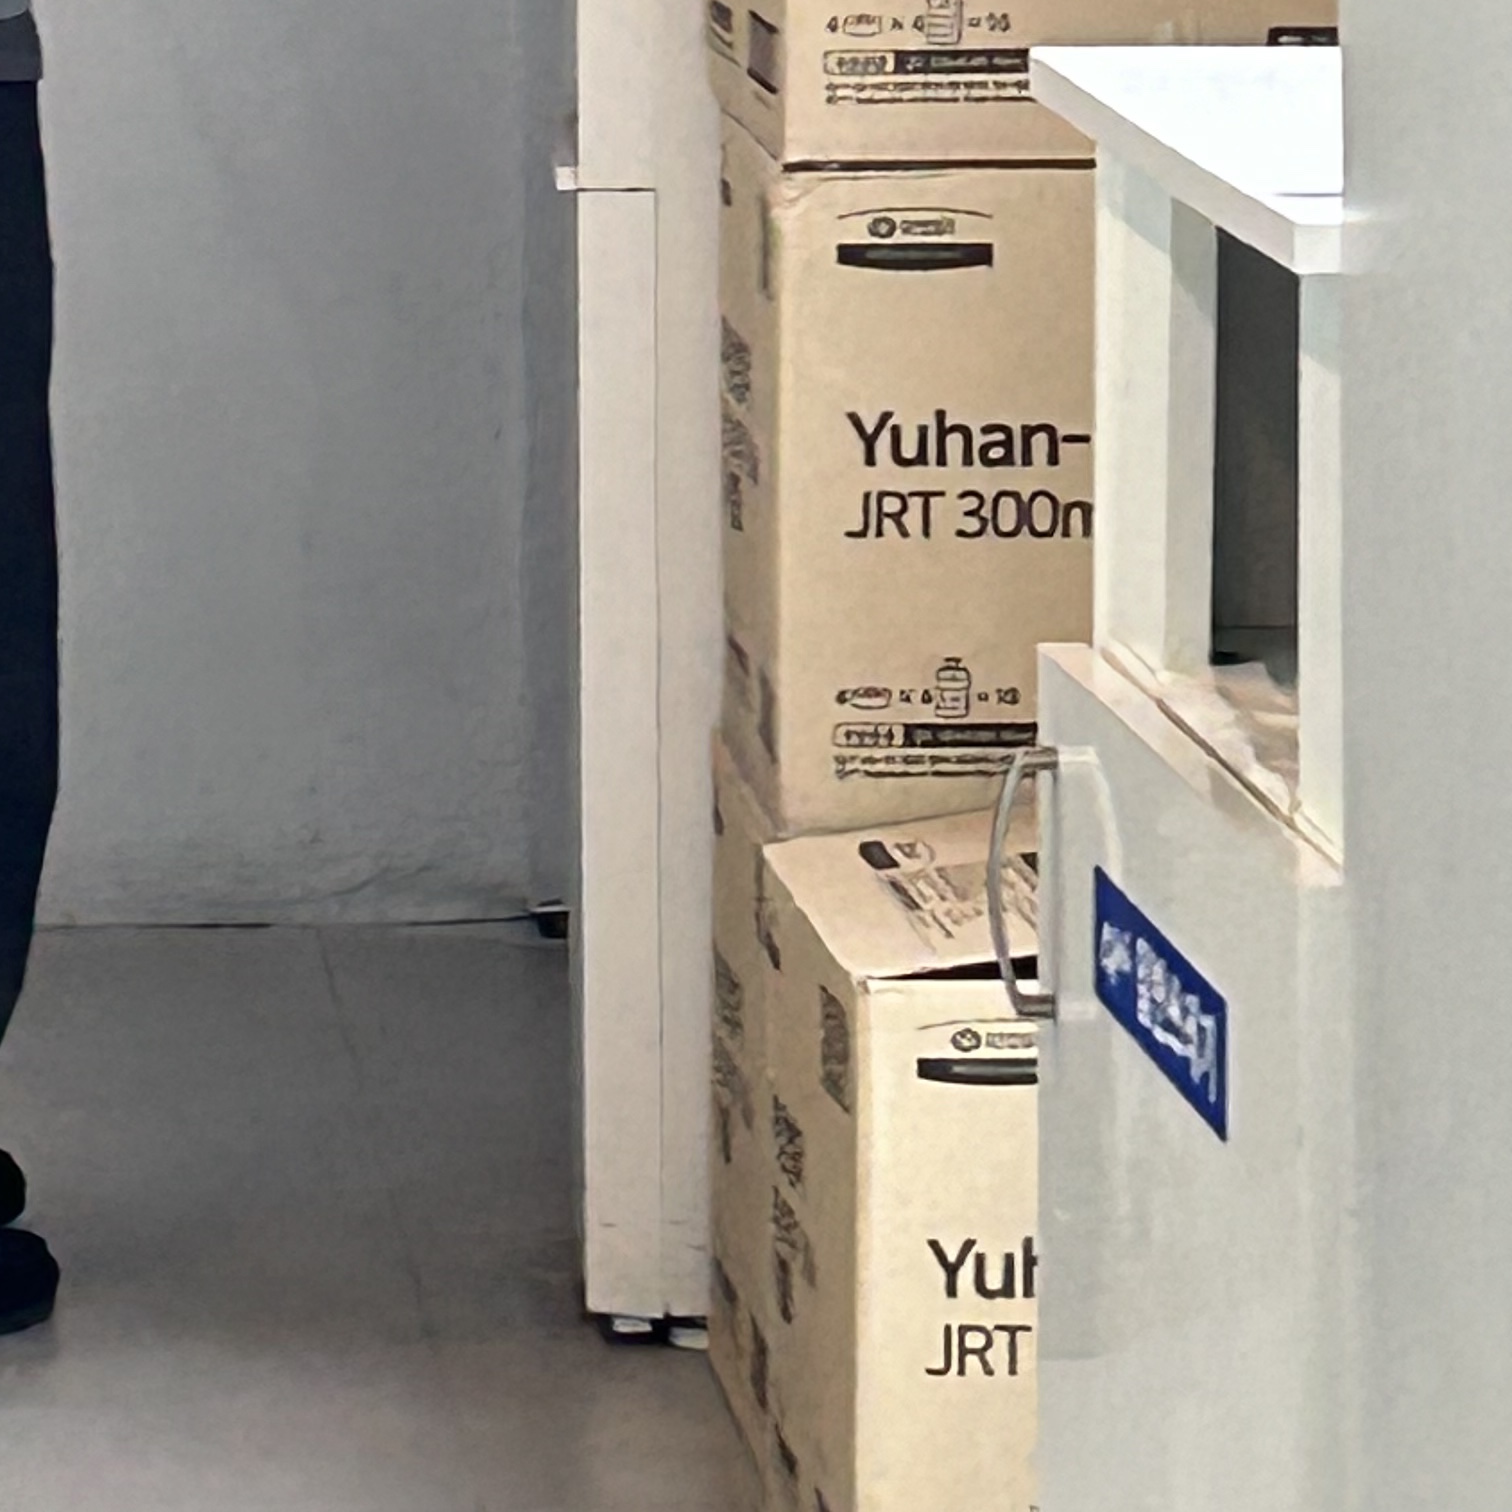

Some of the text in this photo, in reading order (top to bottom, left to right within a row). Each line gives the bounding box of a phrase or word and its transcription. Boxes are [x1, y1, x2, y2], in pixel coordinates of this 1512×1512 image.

[845, 409, 1092, 468] Yuhan-
[843, 490, 946, 538] JRT
[924, 1323, 1033, 1377] JRT
